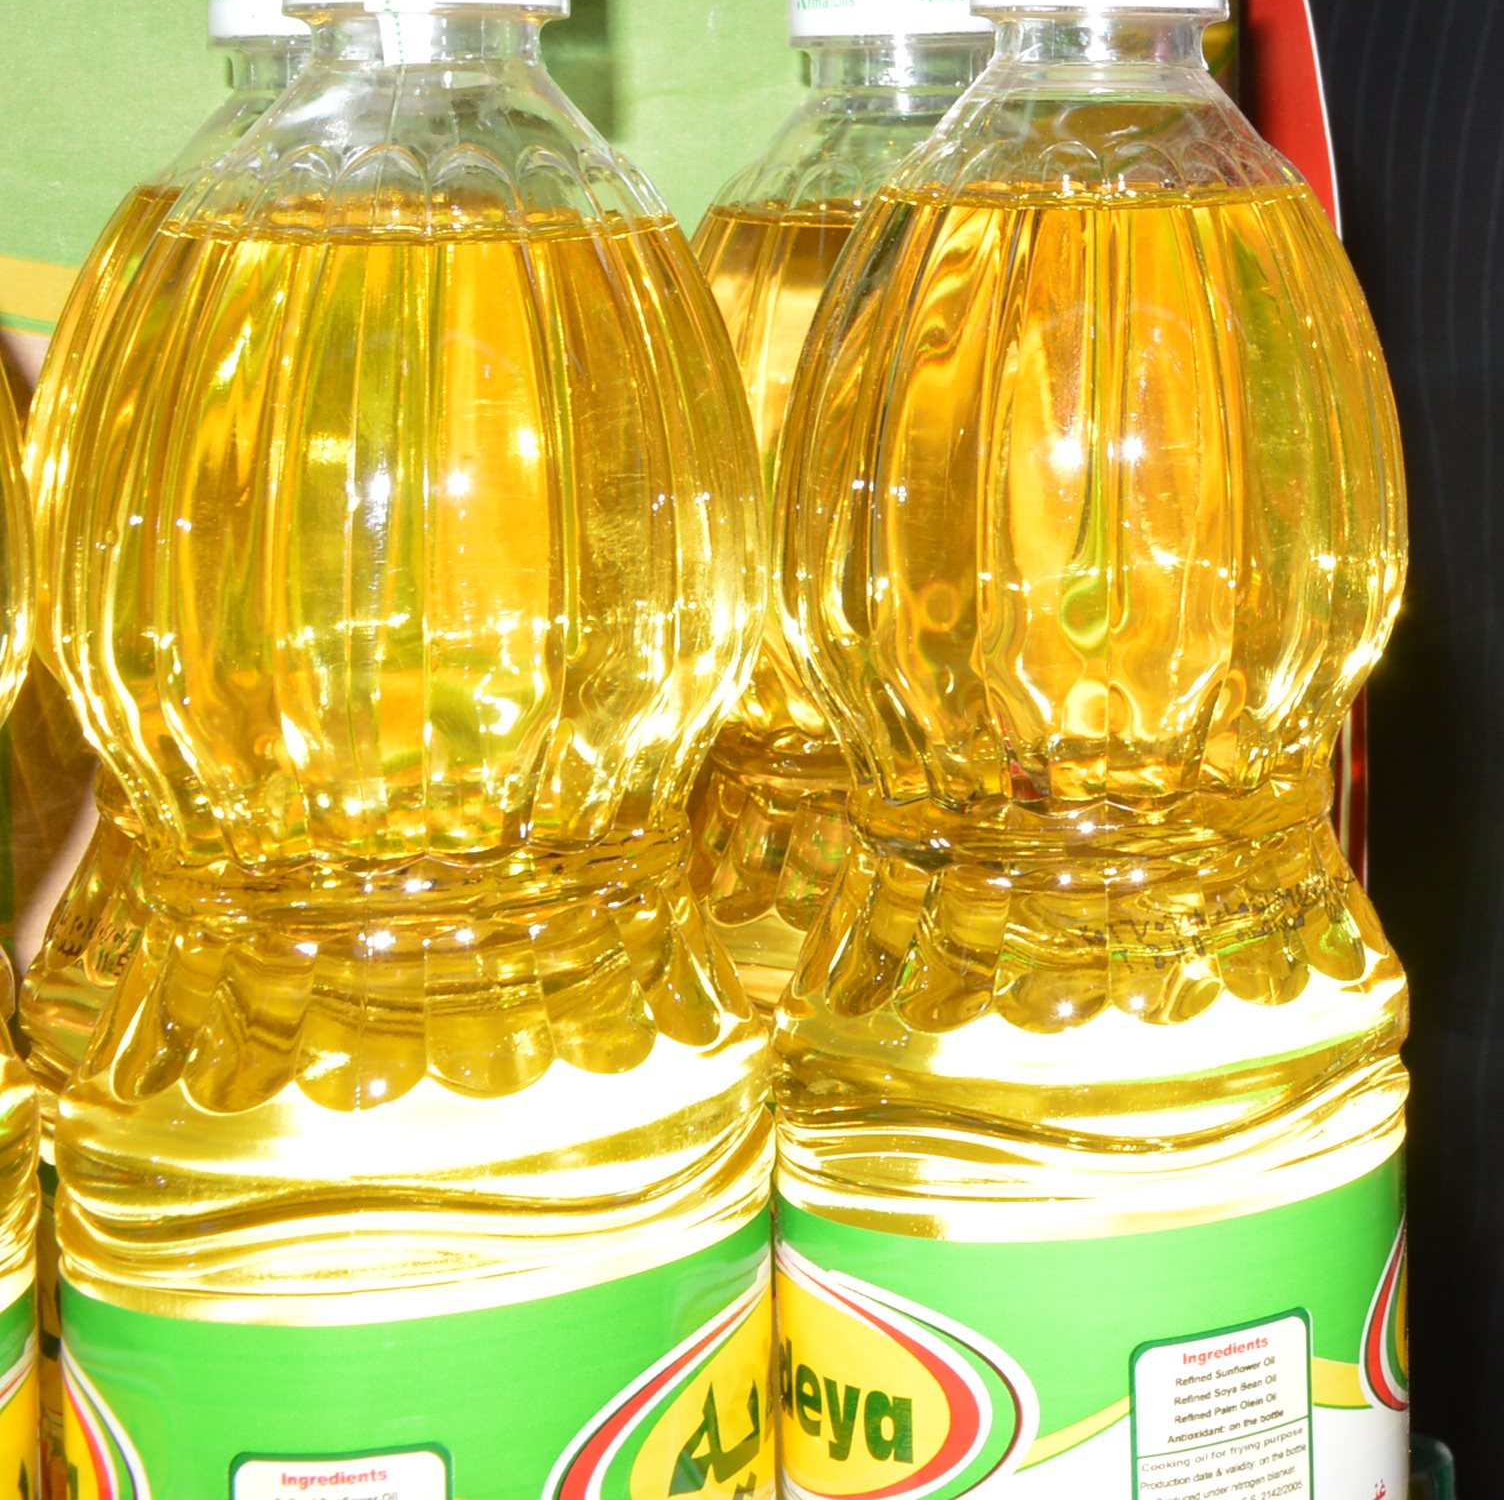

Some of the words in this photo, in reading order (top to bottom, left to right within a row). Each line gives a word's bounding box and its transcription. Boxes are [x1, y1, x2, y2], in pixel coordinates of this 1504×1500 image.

[1182, 1336, 1269, 1367] Ingredients
[1175, 1372, 1213, 1387] Refined
[1215, 1361, 1261, 1380] Sunflower
[1263, 1355, 1276, 1368] Oil
[1173, 1391, 1211, 1406] Refined
[1214, 1384, 1238, 1399] Soya
[1239, 1378, 1263, 1392] Bean
[1264, 1373, 1278, 1385] Oil
[1174, 1409, 1212, 1425] Refined
[1214, 1403, 1238, 1417] Palm
[1239, 1397, 1264, 1411] Olein
[1265, 1392, 1278, 1404] Oil
[1166, 1425, 1226, 1445] Antioxidant:
[1228, 1422, 1242, 1432] on
[1243, 1415, 1258, 1429] the
[1260, 1408, 1285, 1424] bottle
[1141, 1456, 1191, 1473] Cooking
[1194, 1452, 1209, 1464] oil
[1210, 1448, 1227, 1460] for
[1229, 1440, 1261, 1456] frying
[1263, 1426, 1304, 1454] purpose
[281, 1467, 388, 1490] Ingredients
[1139, 1476, 1191, 1492] Production
[1193, 1468, 1214, 1484] date
[1215, 1466, 1223, 1477] &
[1258, 1456, 1270, 1466] on
[1271, 1450, 1284, 1462] the
[1285, 1443, 1307, 1458] bottle
[1203, 1485, 1229, 1500] under
[1231, 1476, 1266, 1493] nitrogen
[1267, 1465, 1296, 1482] blanket
